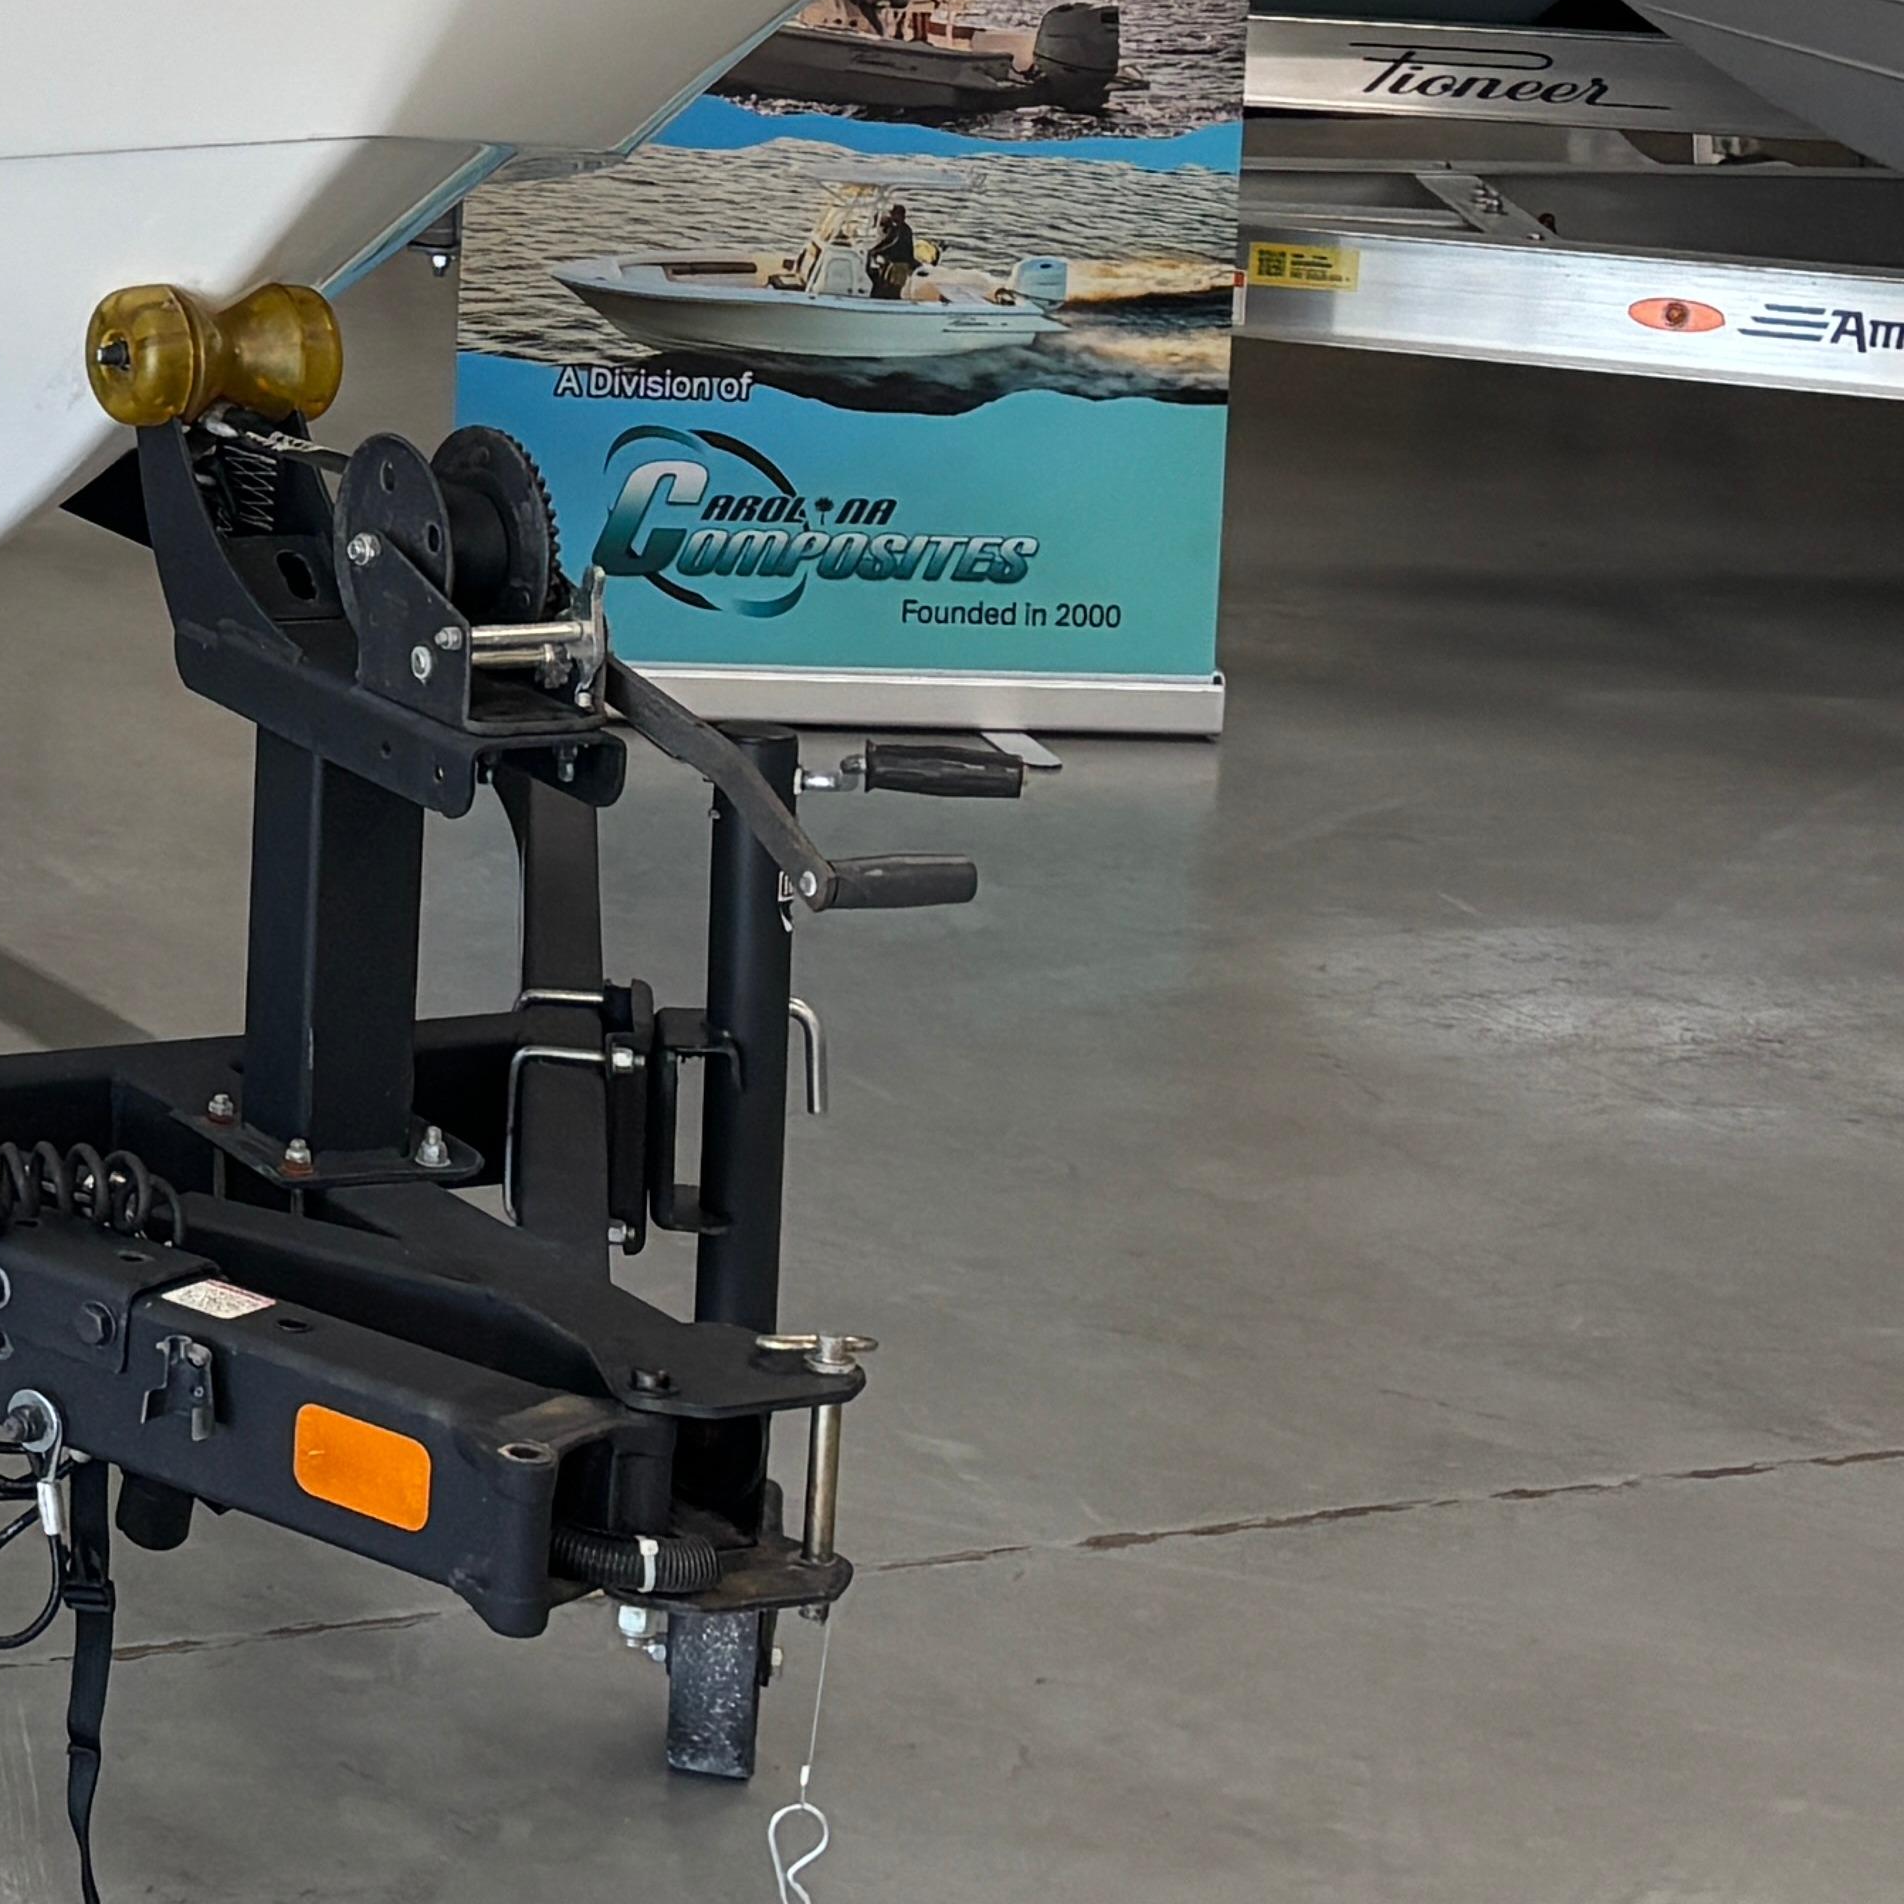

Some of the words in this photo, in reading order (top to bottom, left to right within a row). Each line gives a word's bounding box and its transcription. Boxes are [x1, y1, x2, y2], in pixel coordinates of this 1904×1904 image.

[1348, 42, 1672, 110] Pioneer
[555, 366, 582, 397] A
[590, 367, 711, 400] Division
[718, 371, 754, 402] of
[901, 599, 1017, 628] Founded
[1023, 601, 1048, 628] in
[1055, 603, 1122, 629] 2000
